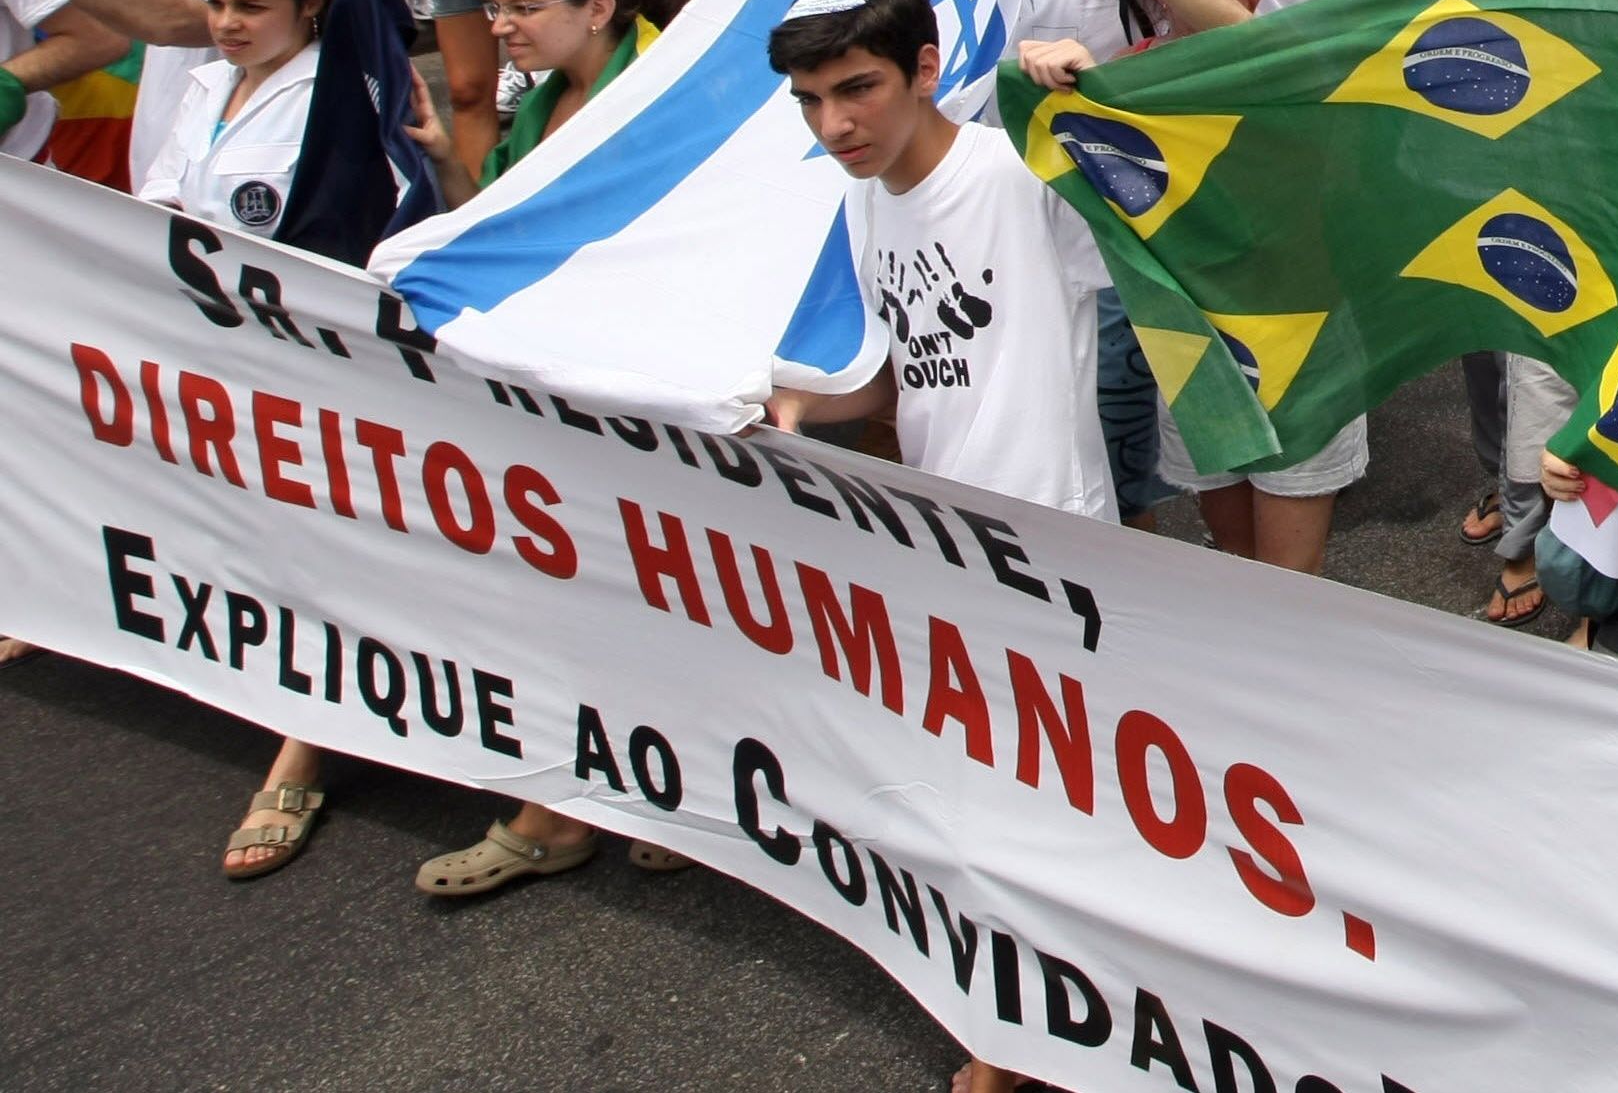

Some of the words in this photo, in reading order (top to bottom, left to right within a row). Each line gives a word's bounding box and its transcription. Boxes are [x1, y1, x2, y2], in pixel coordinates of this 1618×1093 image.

[168, 214, 352, 359] SR.
[900, 358, 970, 391] OUCH
[70, 343, 578, 580] DIREITOS
[103, 525, 524, 760] EXPLIQUE
[574, 703, 682, 811] AO
[732, 735, 1416, 1093] CONVIDAD
[617, 497, 1376, 962] HUMANOS.
